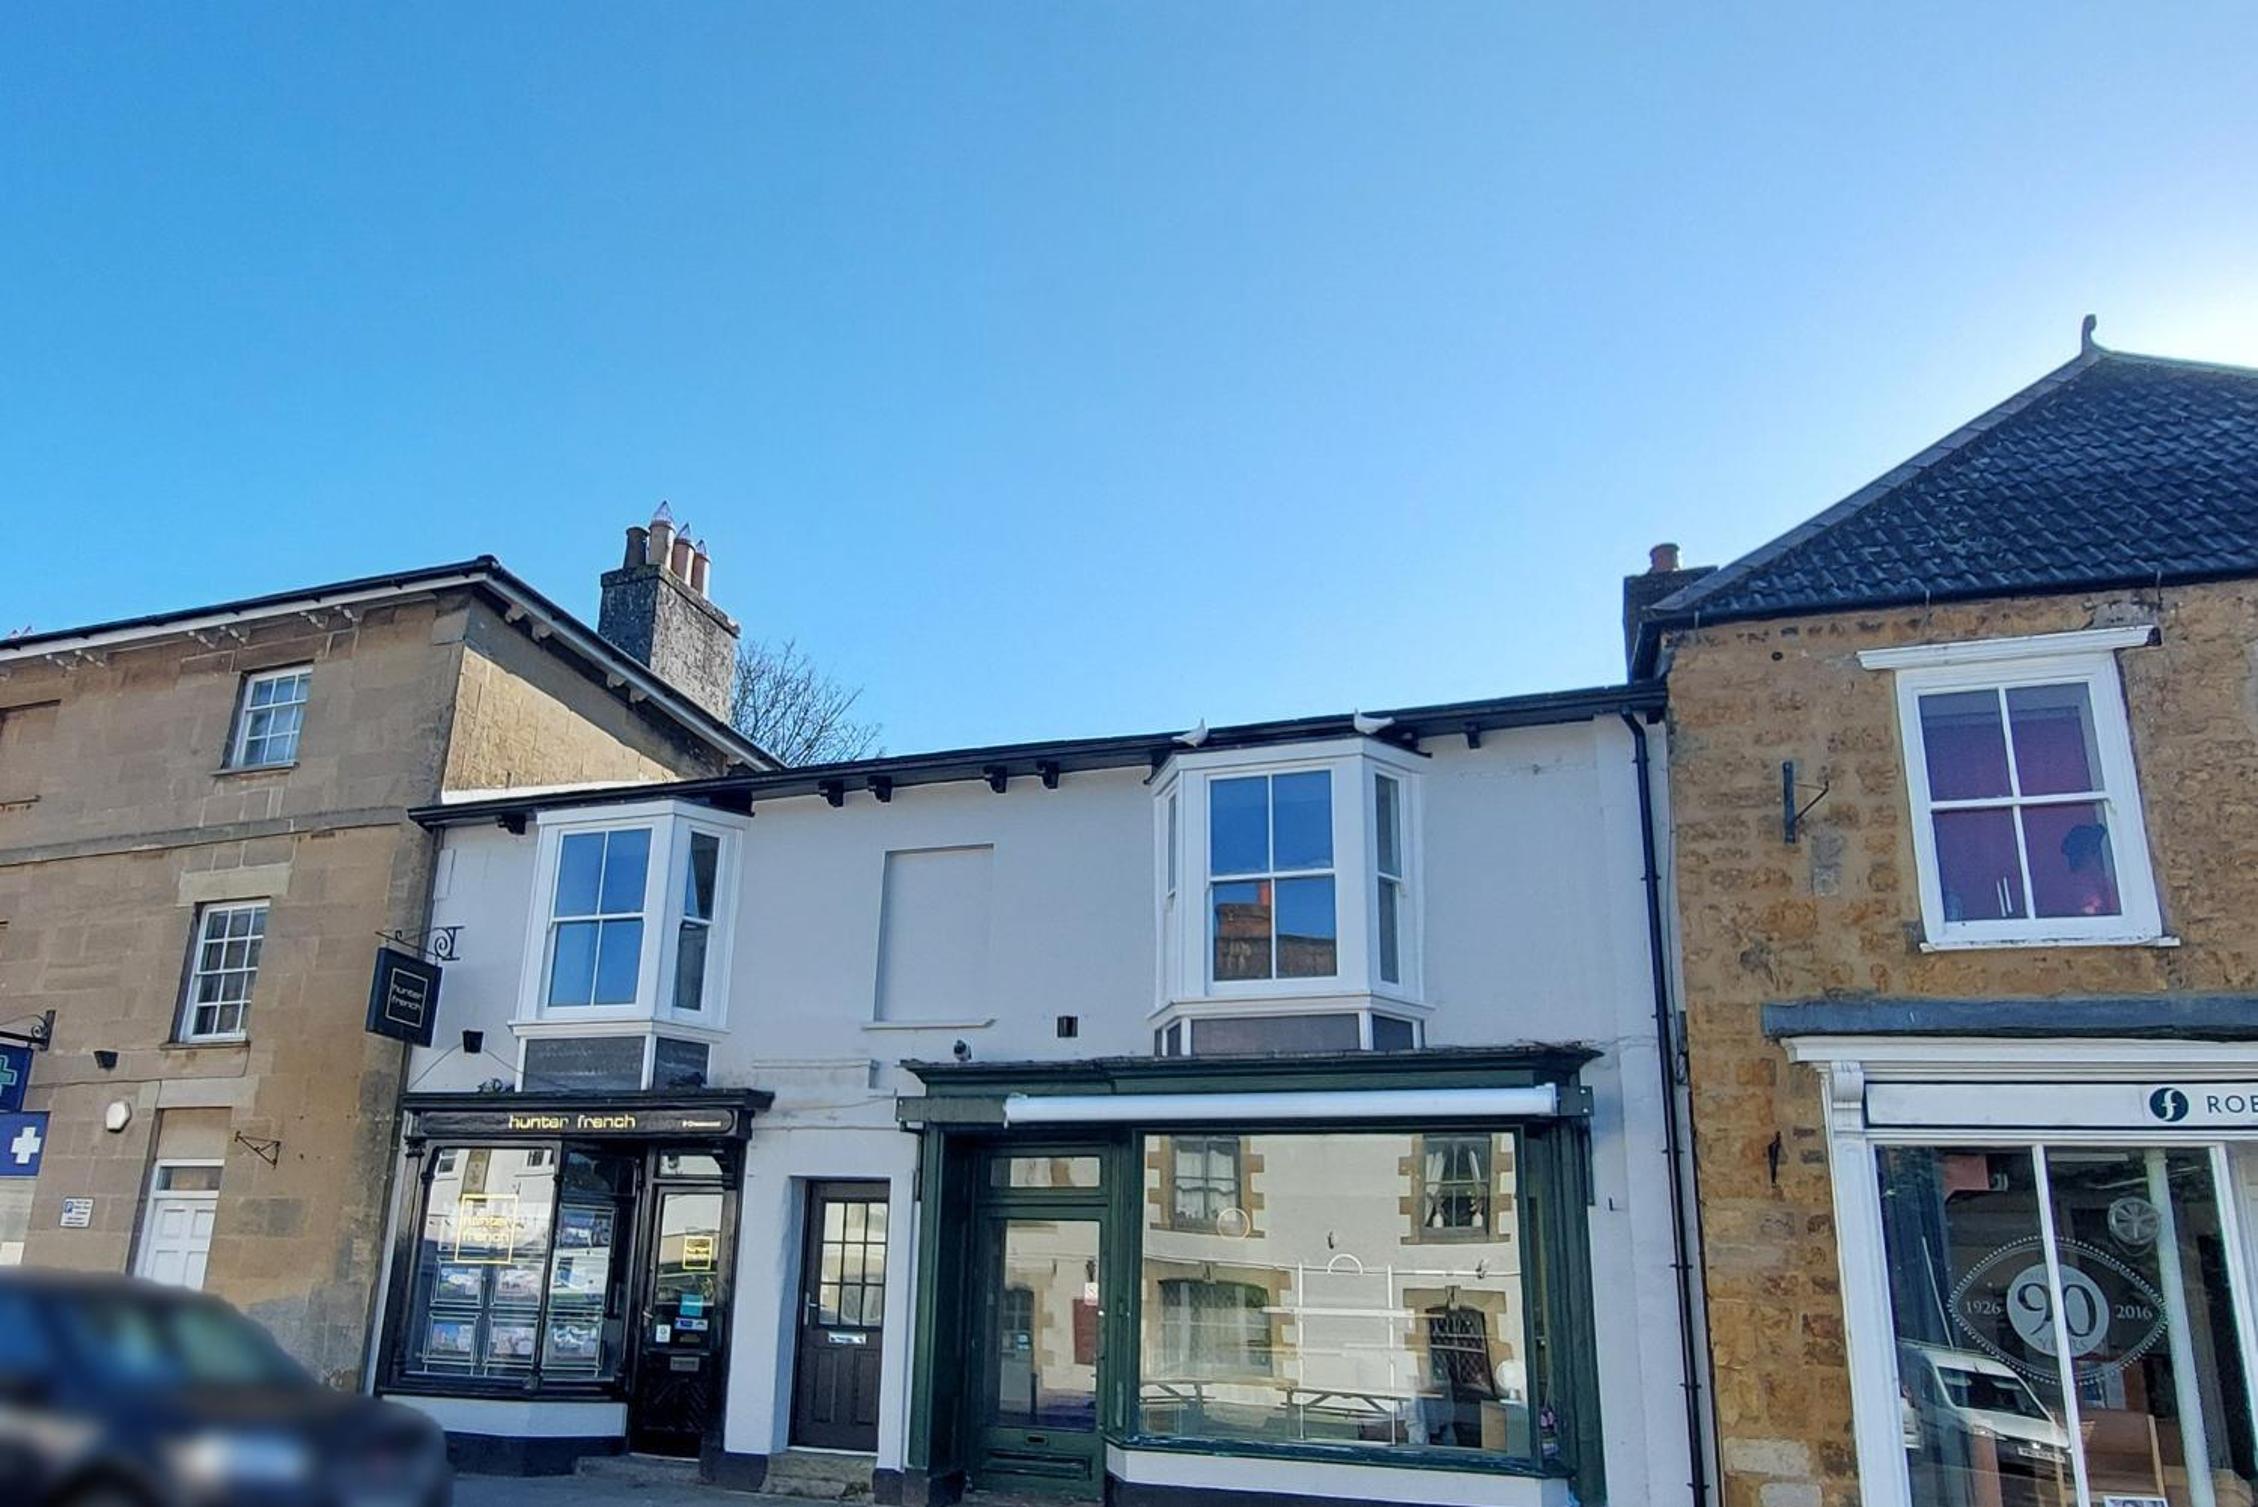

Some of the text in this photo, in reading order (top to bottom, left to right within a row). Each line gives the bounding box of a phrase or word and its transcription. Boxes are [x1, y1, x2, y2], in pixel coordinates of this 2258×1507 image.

[508, 1114, 636, 1129] hunter french
[2017, 1282, 2097, 1338] 90
[2116, 1304, 2153, 1320] 2016
